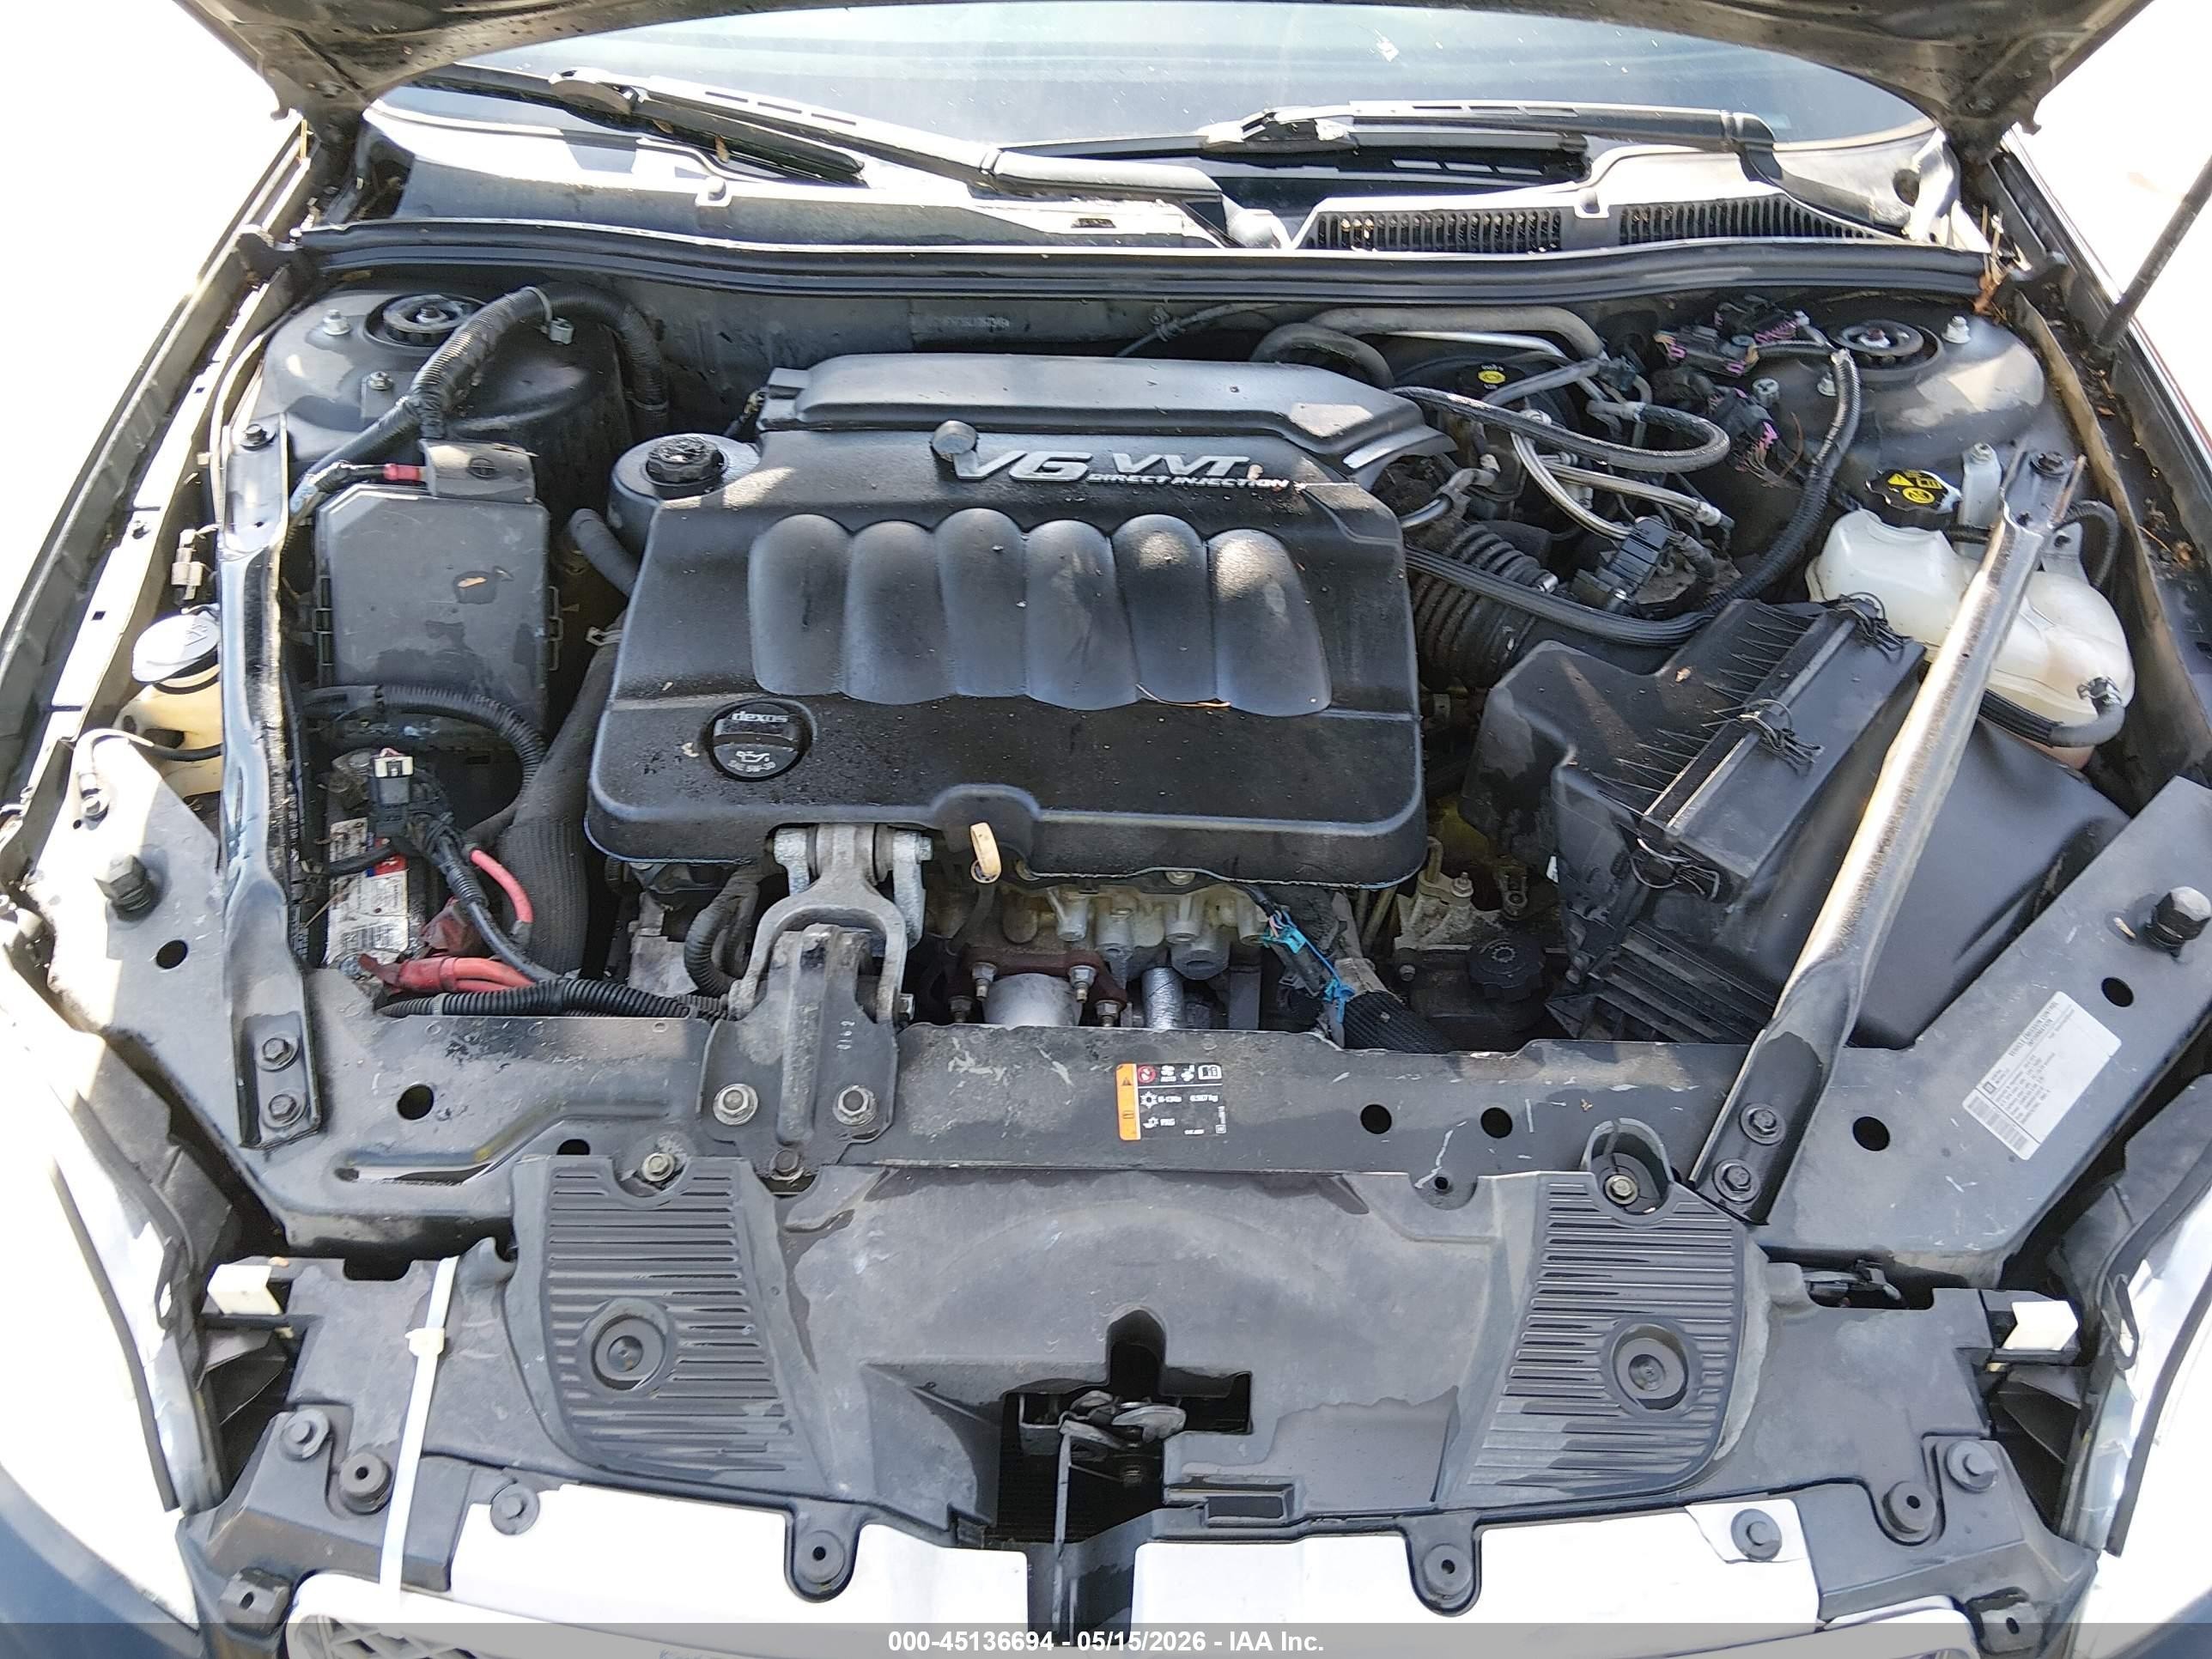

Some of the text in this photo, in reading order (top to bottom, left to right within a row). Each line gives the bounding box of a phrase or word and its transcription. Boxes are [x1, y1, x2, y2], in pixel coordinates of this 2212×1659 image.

[953, 449, 1251, 481] V6 VVT
[1086, 472, 1290, 489] DIRECT INJECTION
[732, 711, 789, 723] dexos
